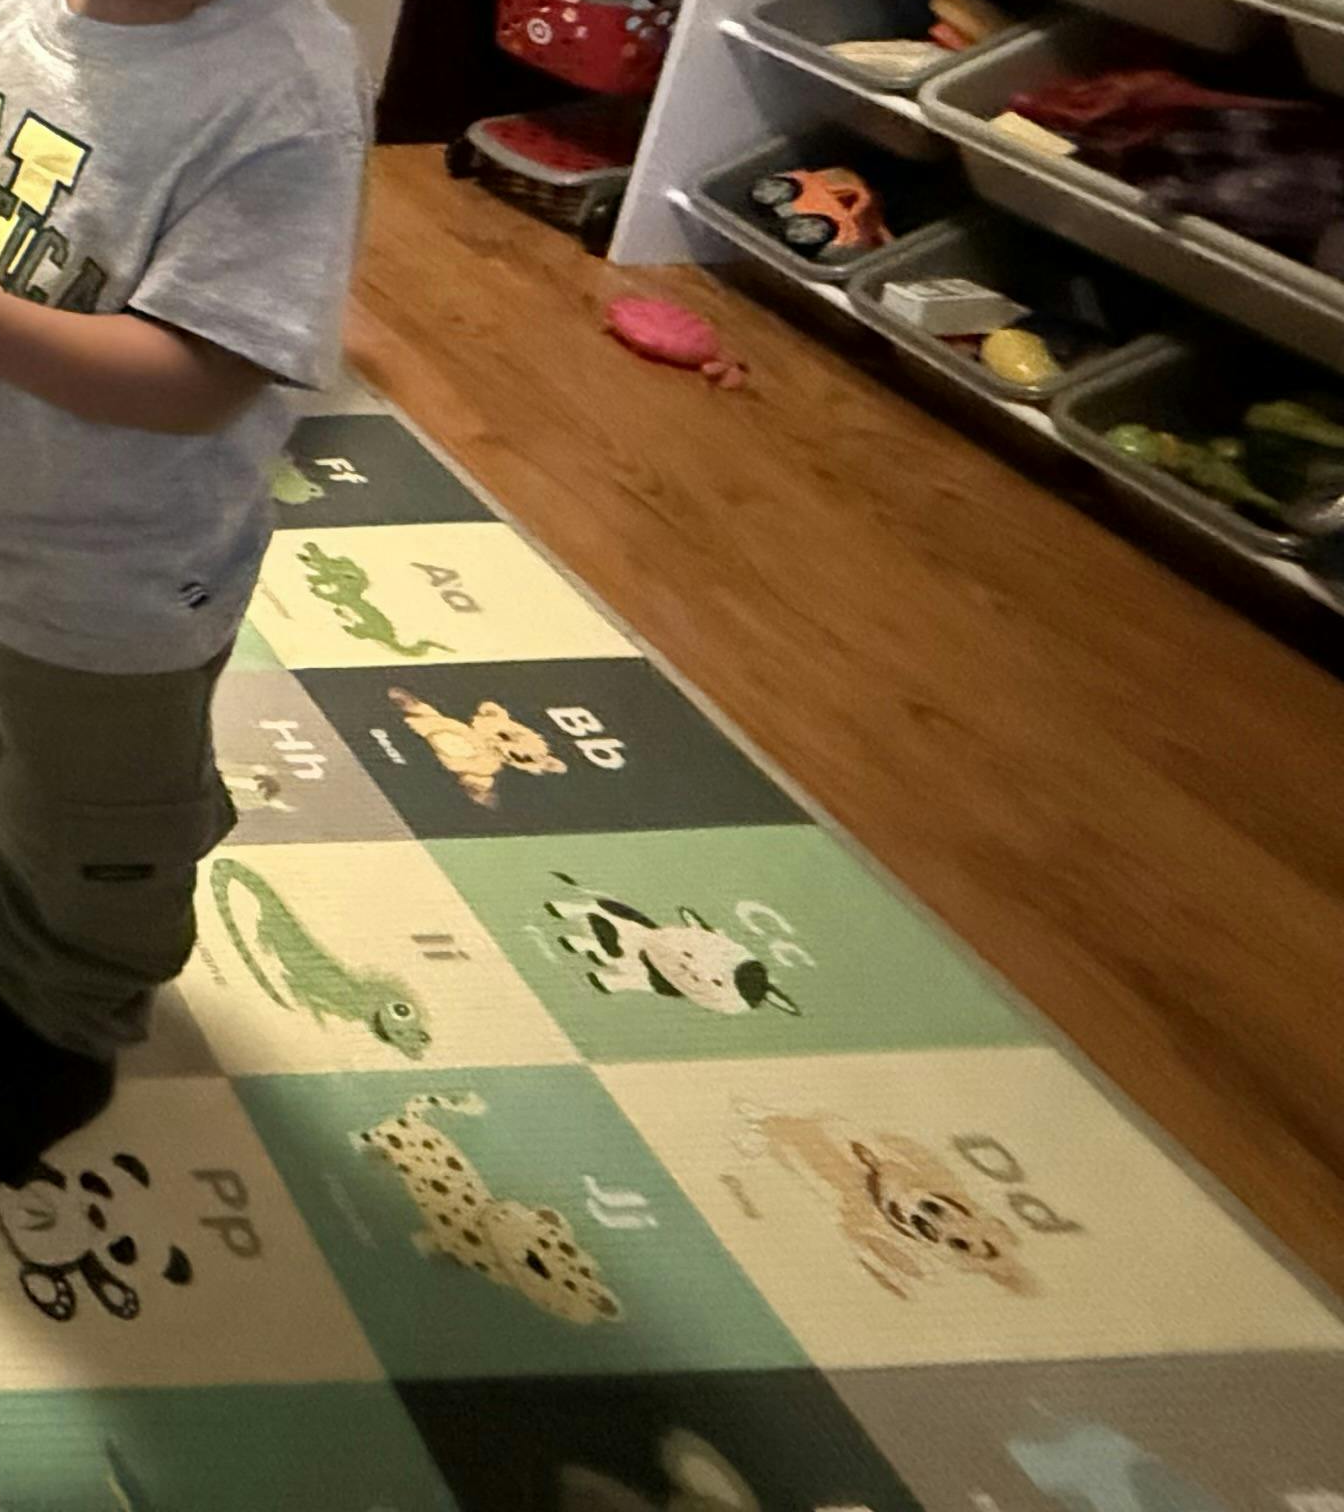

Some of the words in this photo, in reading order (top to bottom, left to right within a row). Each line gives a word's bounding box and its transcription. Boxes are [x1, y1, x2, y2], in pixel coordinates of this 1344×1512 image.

[313, 455, 369, 486] Ff
[409, 560, 483, 615] Aa
[254, 717, 328, 780] Hh
[544, 704, 634, 773] Bb
[410, 932, 472, 962] Ii
[734, 899, 816, 970] Cc
[188, 1167, 265, 1262] Pp
[580, 1174, 660, 1231] Jj
[950, 1130, 1086, 1236] Dd
